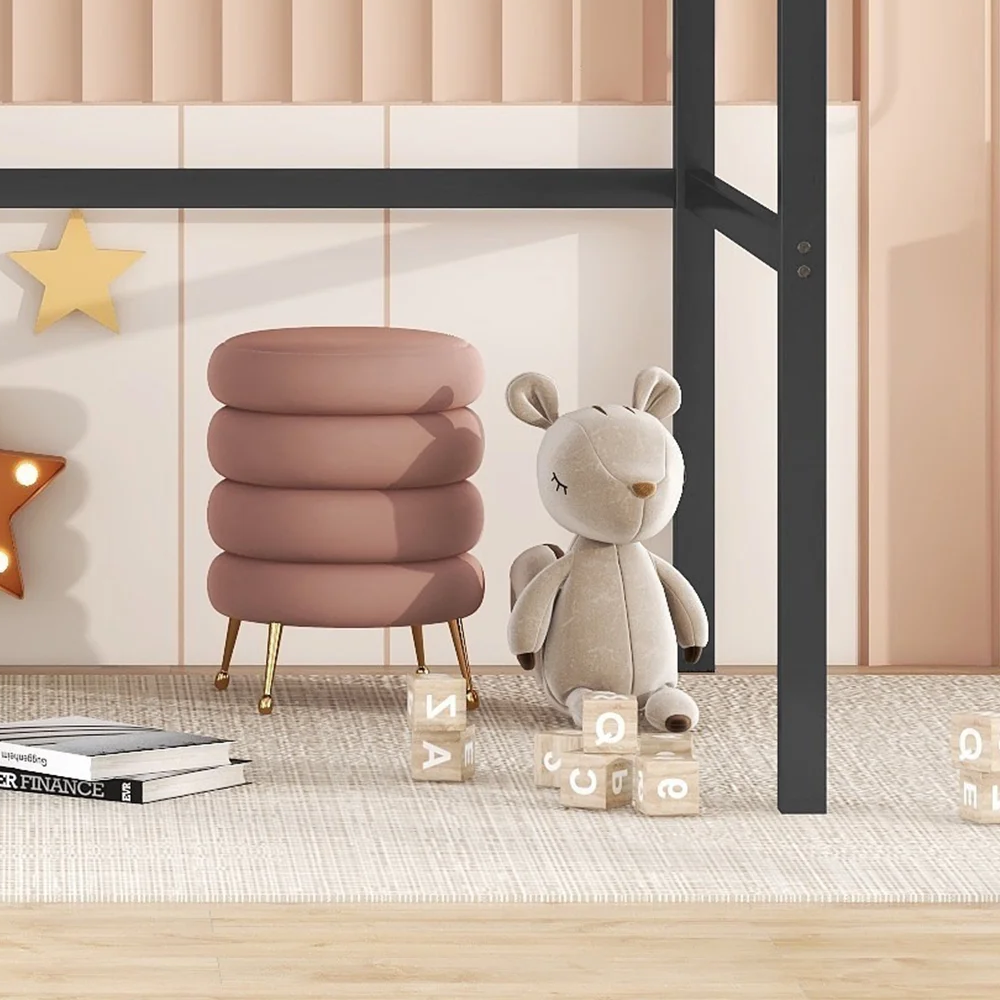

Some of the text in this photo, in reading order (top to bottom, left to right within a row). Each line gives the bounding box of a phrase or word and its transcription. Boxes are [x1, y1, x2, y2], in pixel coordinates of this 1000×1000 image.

[1, 752, 47, 767] Guggenheim
[20, 774, 105, 798] FINANCE
[121, 782, 131, 801] EVR
